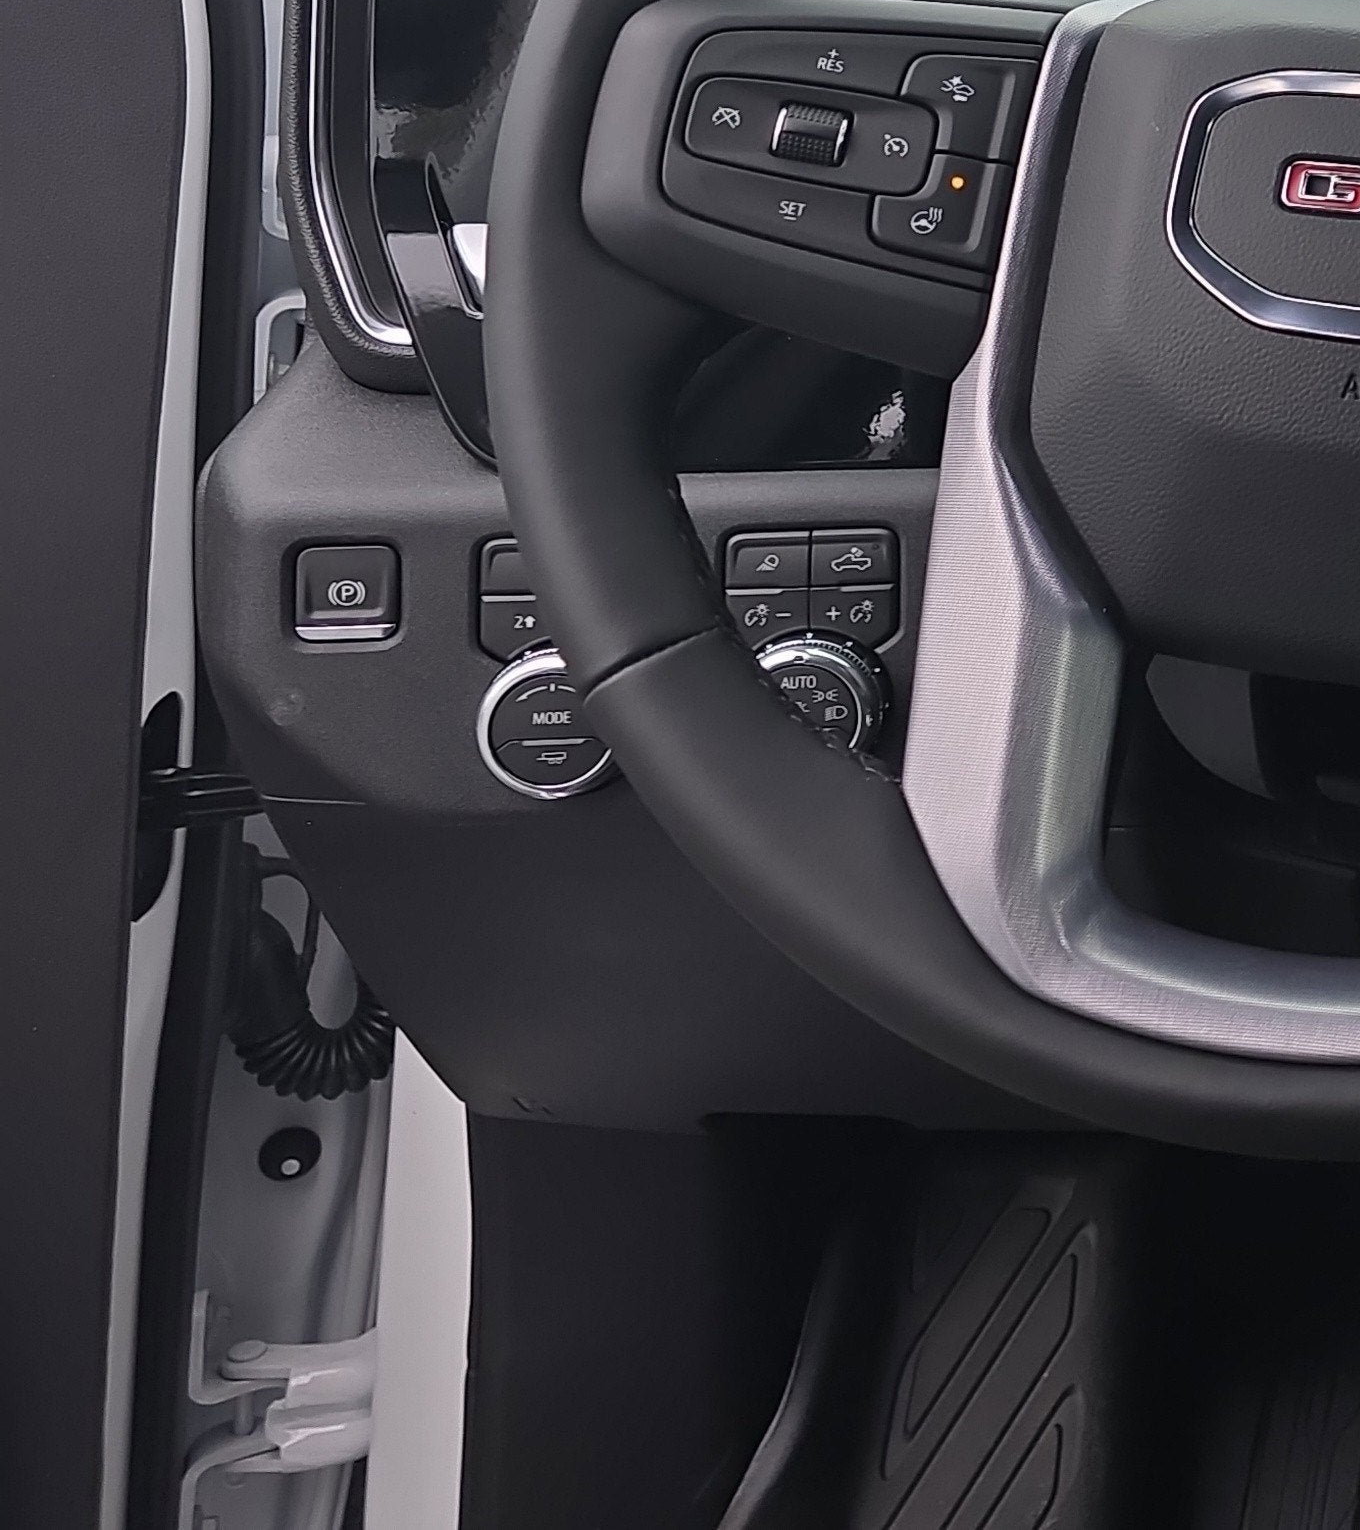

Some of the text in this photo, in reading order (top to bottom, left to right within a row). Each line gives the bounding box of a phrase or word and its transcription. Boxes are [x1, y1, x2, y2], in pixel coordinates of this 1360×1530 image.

[817, 57, 844, 73] RES
[779, 200, 806, 217] SET
[780, 675, 817, 689] AUTO
[531, 711, 572, 725] MODE
